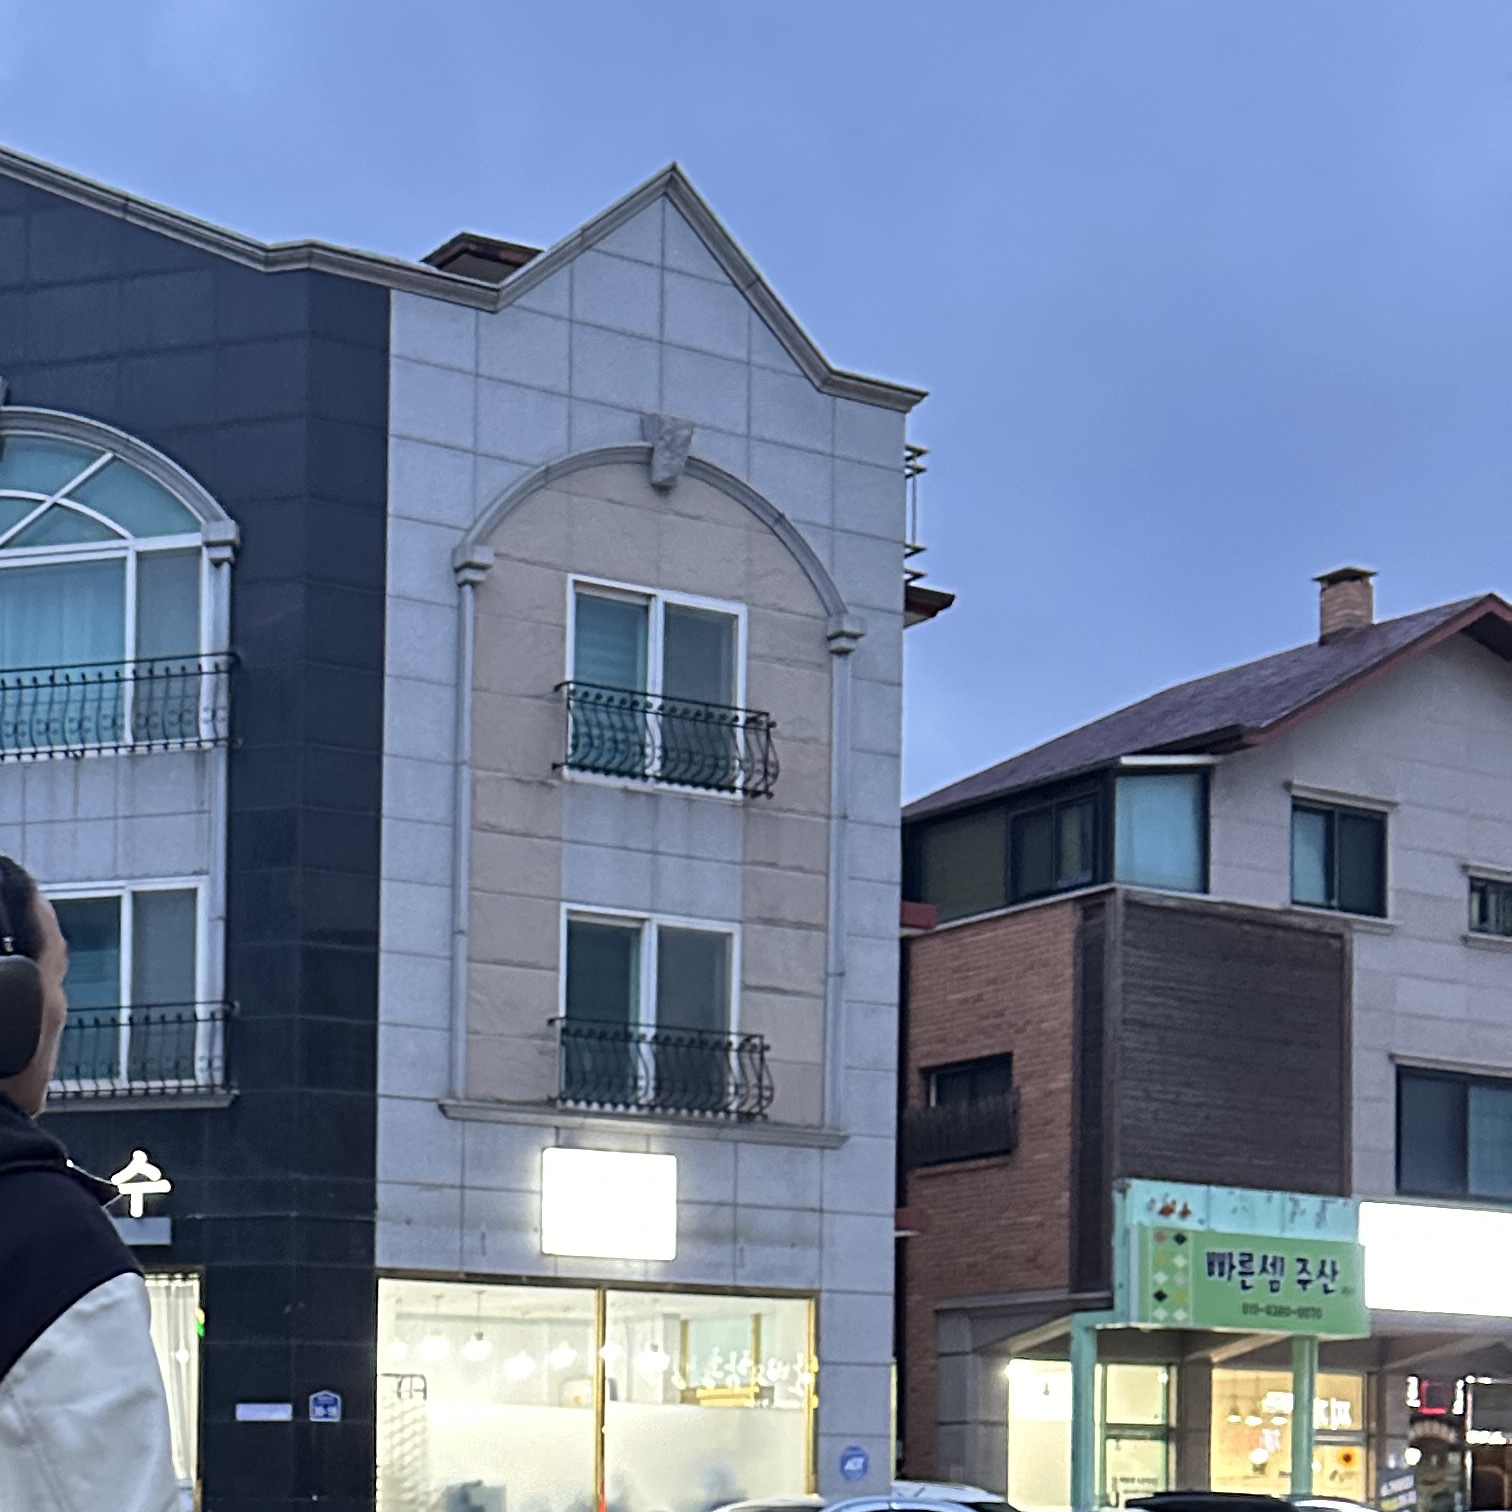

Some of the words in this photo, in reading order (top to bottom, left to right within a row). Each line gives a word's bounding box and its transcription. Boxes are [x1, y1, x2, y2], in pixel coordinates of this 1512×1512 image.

[111, 1150, 171, 1218] 수
[1206, 1252, 1285, 1292] 빠른셈
[1296, 1257, 1338, 1294] 주산
